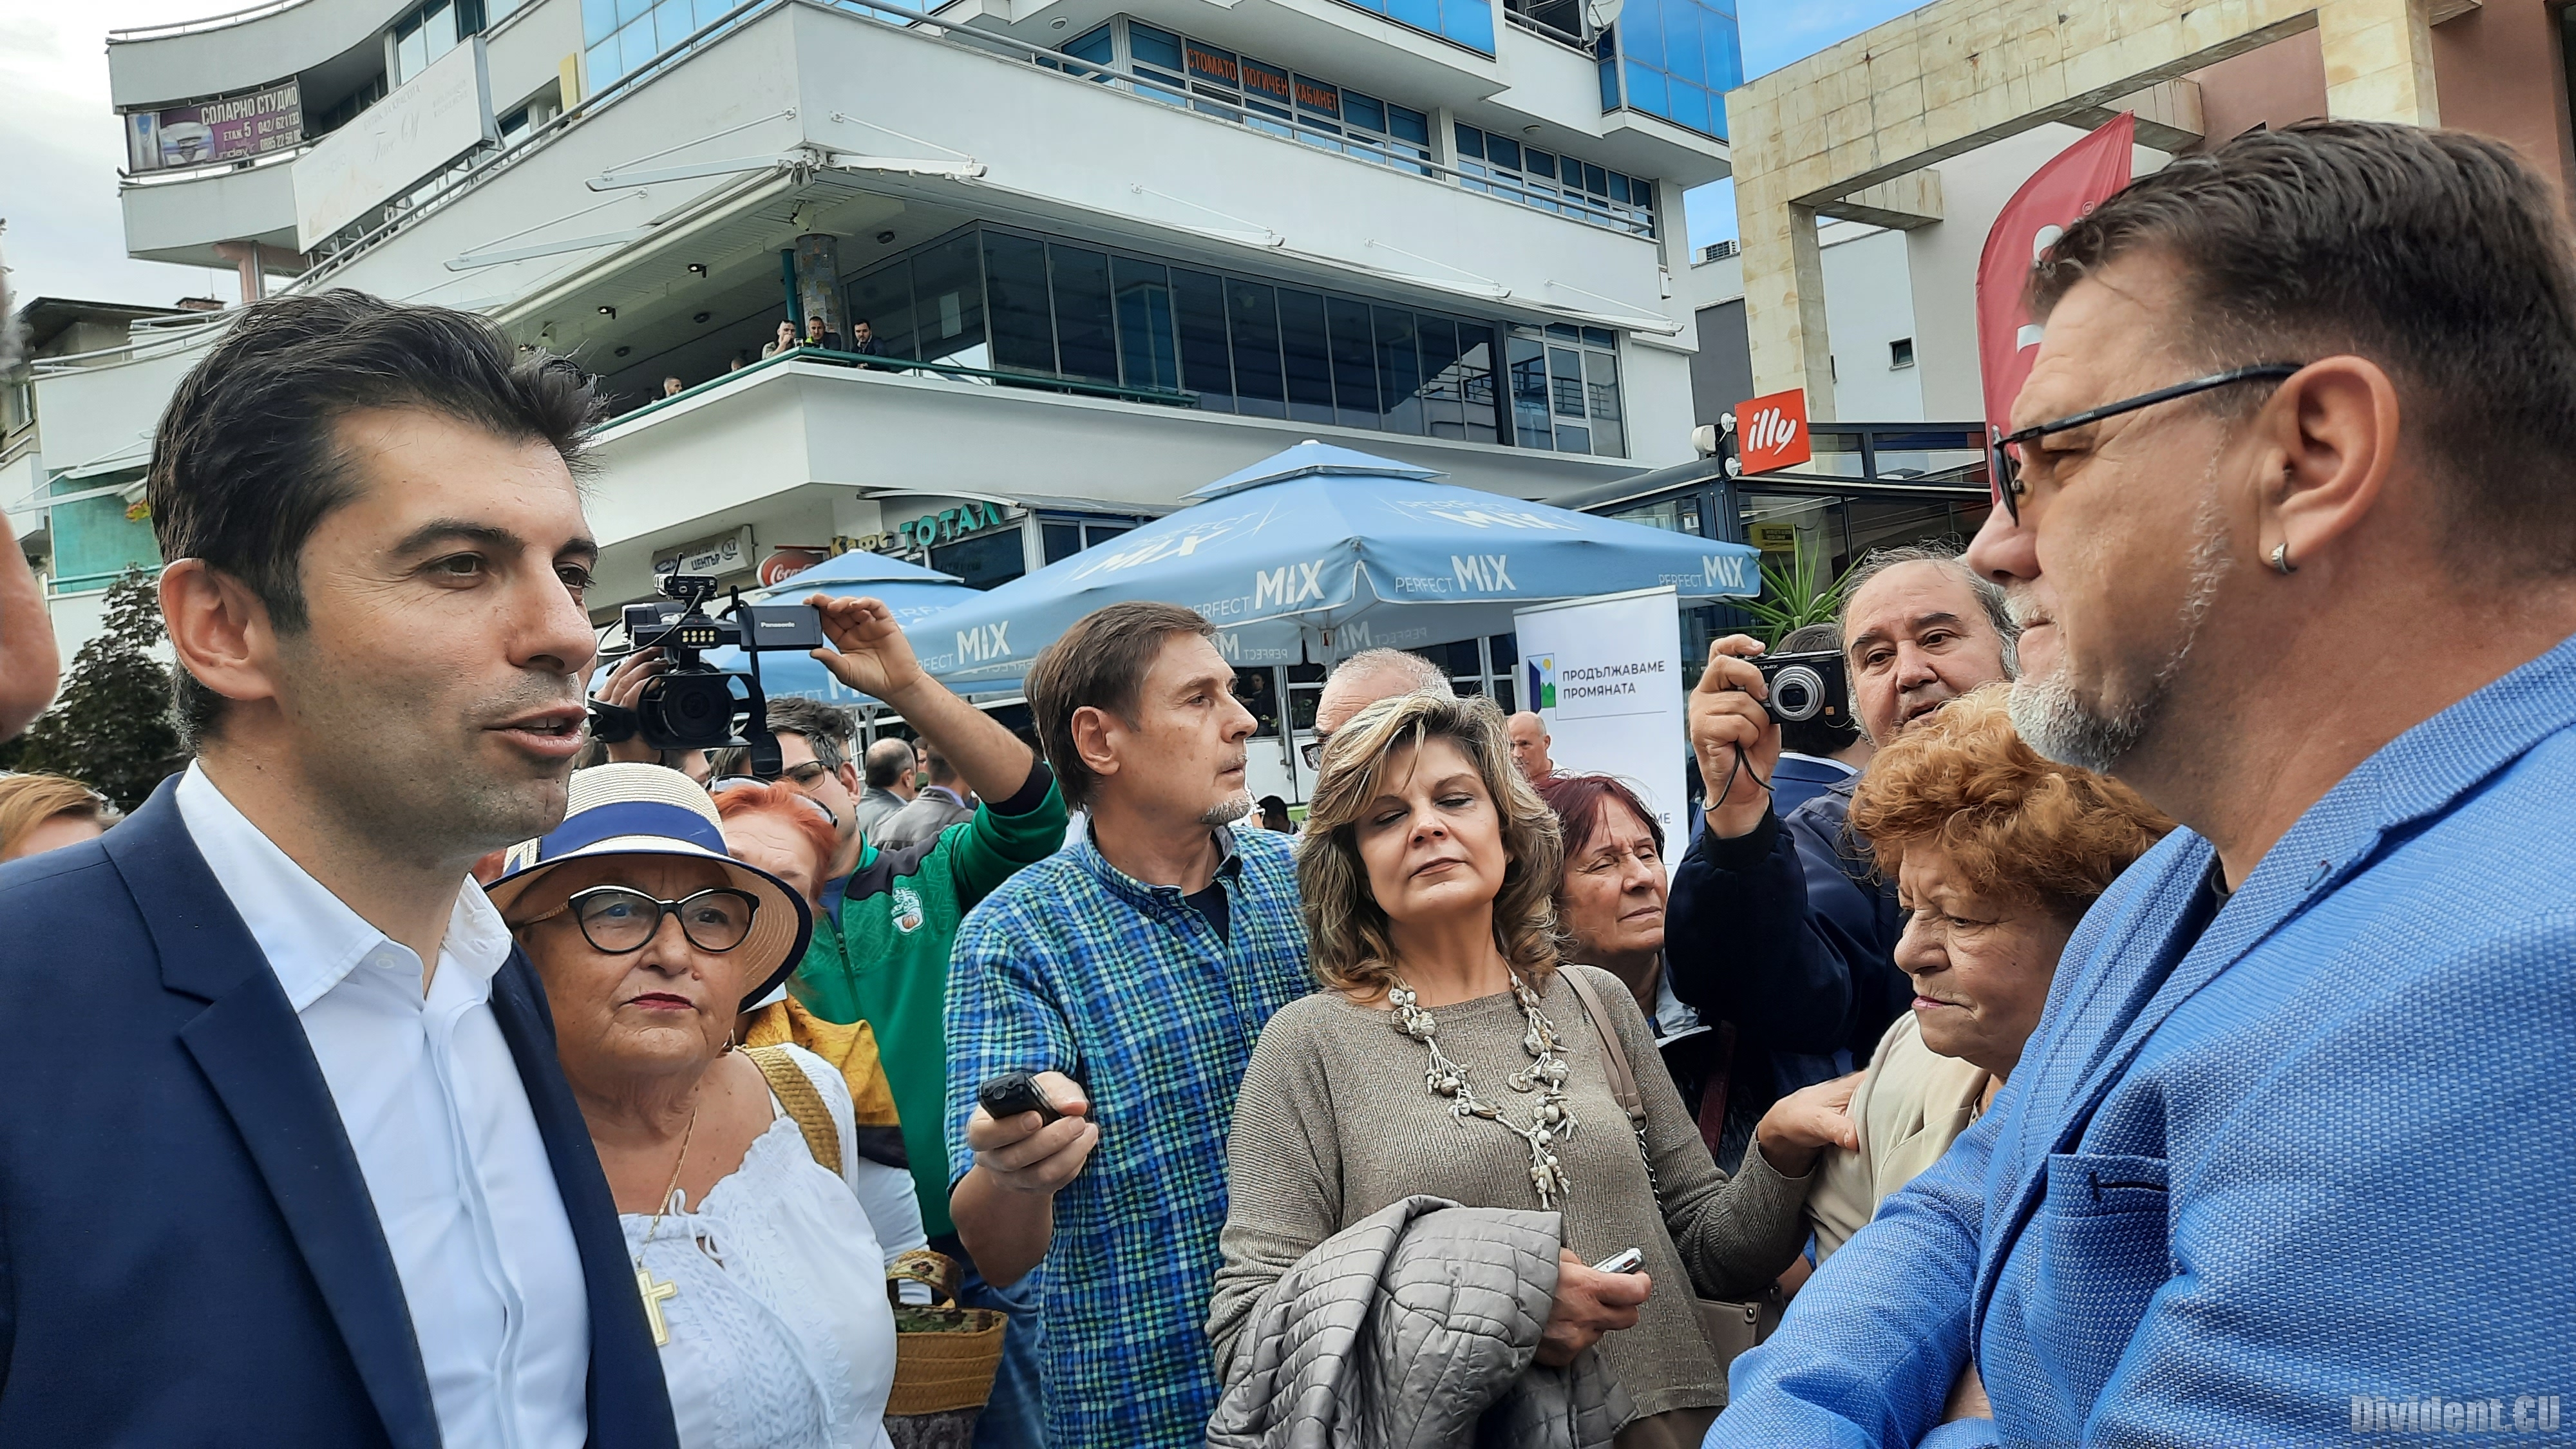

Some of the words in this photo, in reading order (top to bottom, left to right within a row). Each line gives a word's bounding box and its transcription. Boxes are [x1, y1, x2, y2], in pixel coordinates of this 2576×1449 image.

[201, 98, 255, 126] СОЛАРНО
[257, 86, 298, 115] СТУДИО
[1293, 82, 1337, 111] КАБИНЕТ
[223, 129, 243, 141] ЕТАЖ
[243, 120, 252, 137] 5
[258, 118, 275, 135] 042/
[276, 134, 285, 148] 22
[1748, 407, 1797, 456] illy
[830, 531, 893, 556] Кафе
[900, 500, 1001, 551] ТОТАЛ
[691, 553, 721, 571] ЦЕНТЪР
[1395, 576, 1453, 593] PERFECT
[1451, 554, 1517, 592] MIX
[1658, 574, 1703, 587] PERFECT
[1702, 555, 1745, 589] MIX
[1255, 559, 1325, 610] MIX
[956, 620, 1012, 665] MIX
[1562, 660, 1665, 682] ПРОДЪЛЖАВАМЕ
[1563, 683, 1636, 699] ПРОМЯНАТА
